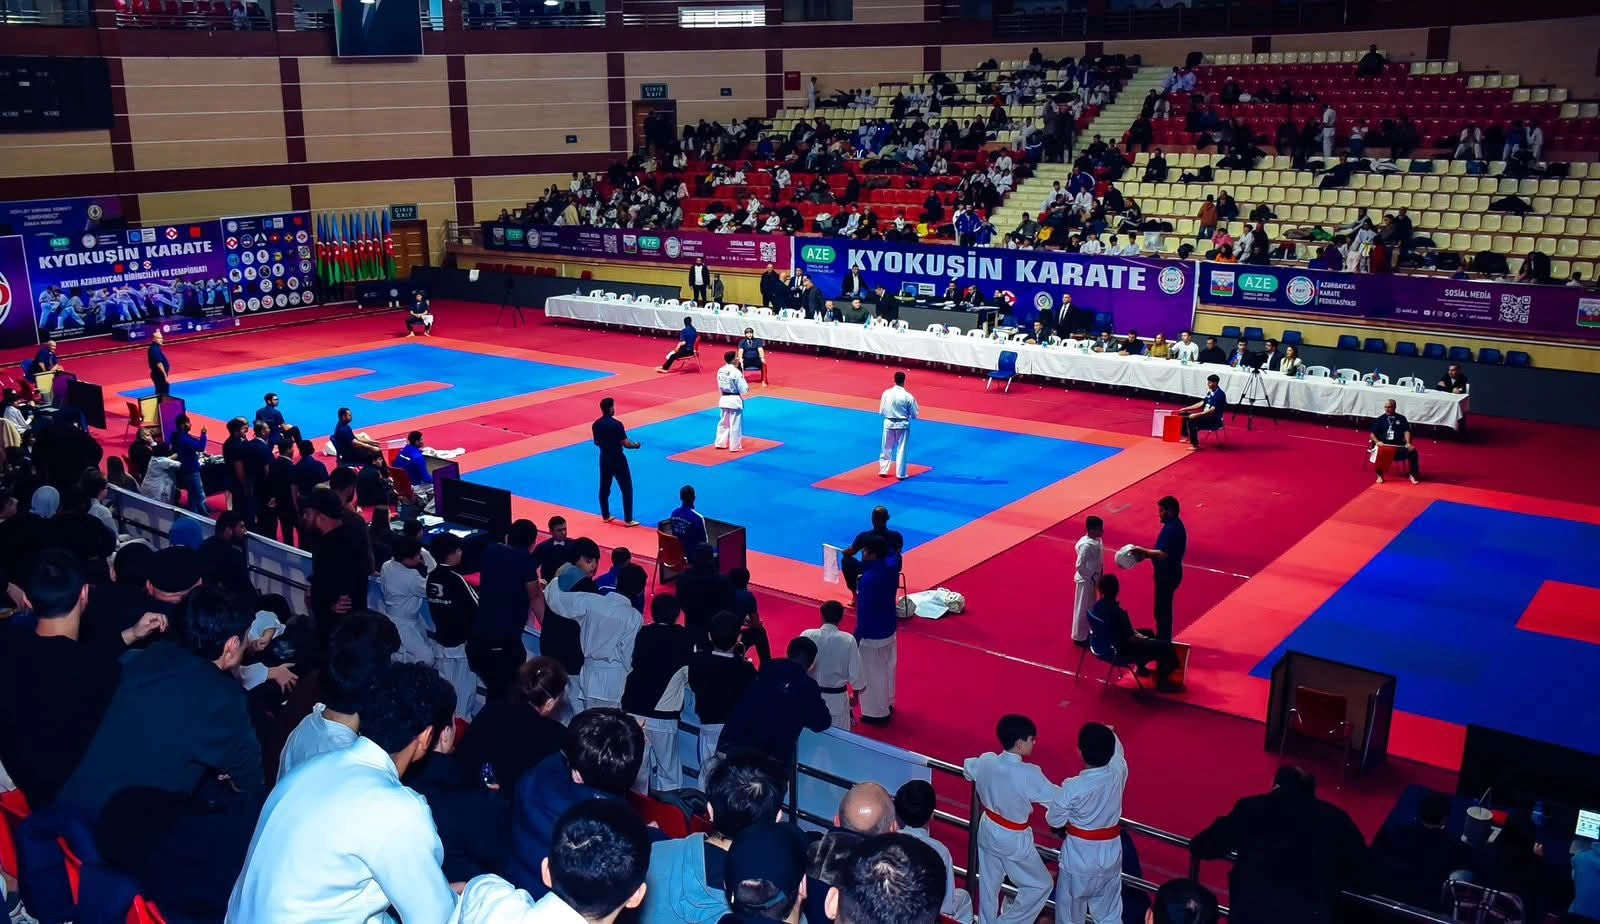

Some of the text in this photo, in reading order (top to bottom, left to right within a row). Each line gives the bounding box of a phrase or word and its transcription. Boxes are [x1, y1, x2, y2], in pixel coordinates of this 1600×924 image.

[38, 240, 213, 270] KYOKUŞİN KARATE
[807, 248, 829, 261] AZE
[848, 249, 1147, 291] KYOKUŞİN KARATE
[1244, 276, 1272, 289] AZE
